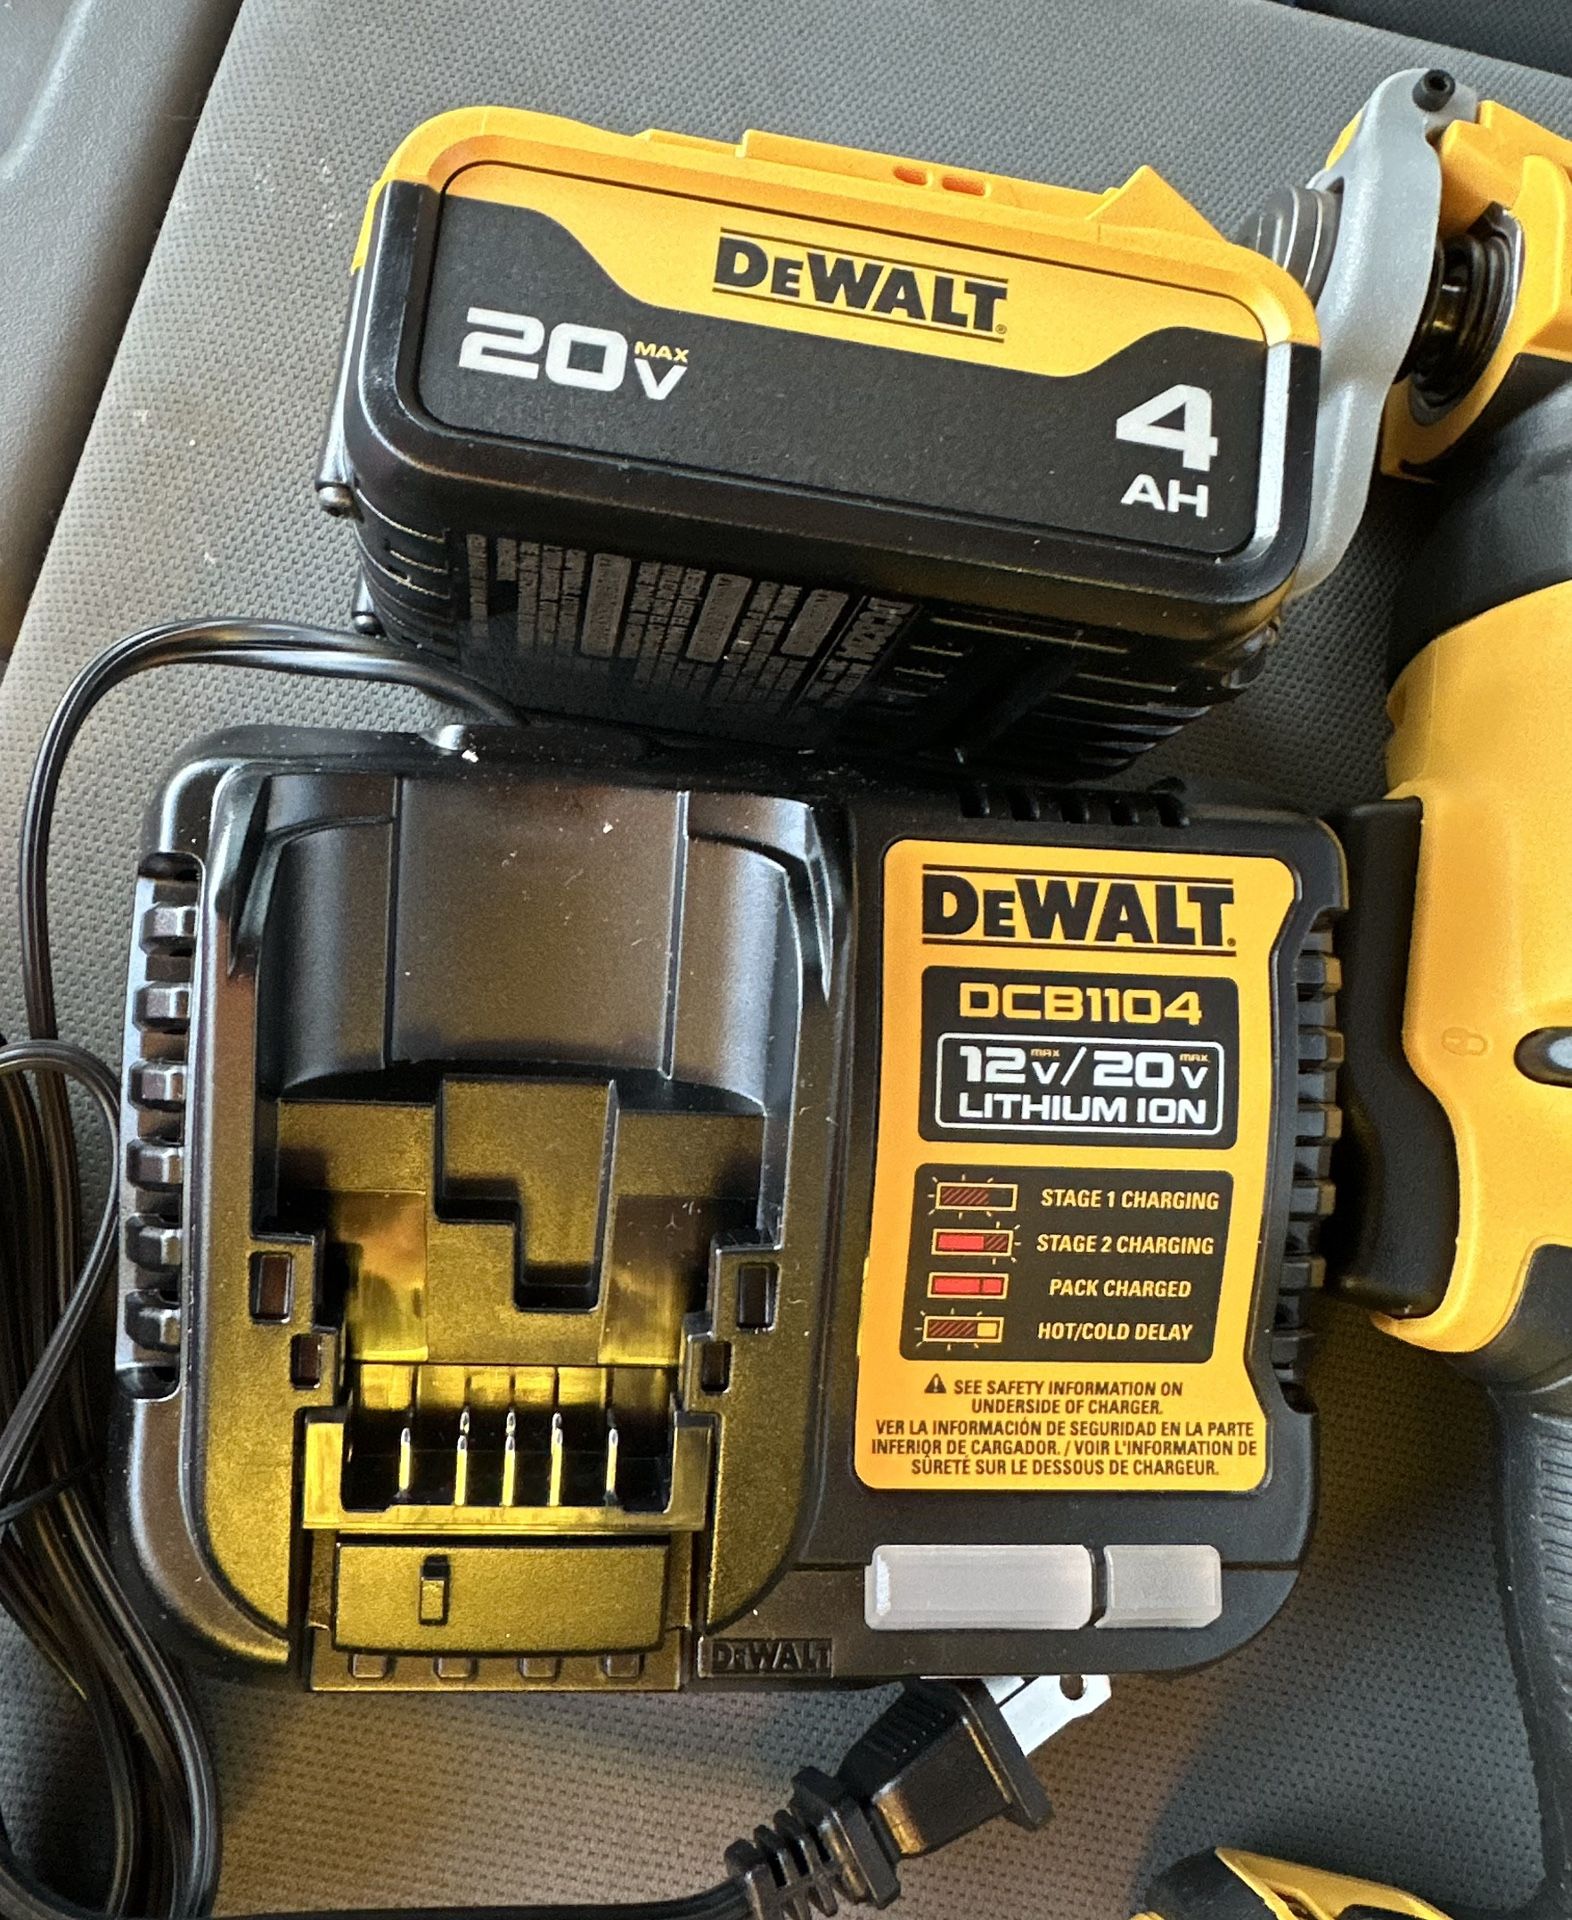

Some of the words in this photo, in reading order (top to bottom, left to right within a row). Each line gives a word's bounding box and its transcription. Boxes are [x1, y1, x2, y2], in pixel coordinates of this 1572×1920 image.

[712, 235, 1008, 334] DEWALT
[634, 341, 689, 364] MAX
[1116, 384, 1218, 472] 4
[1120, 473, 1209, 518] AH
[922, 873, 1235, 946] DEWALT
[959, 982, 1202, 1026] DCB1104
[959, 1092, 1127, 1123] LITHIUM
[1137, 1098, 1206, 1124] ION
[1041, 1188, 1102, 1208] STAGE
[1107, 1191, 1116, 1208] 1
[1121, 1190, 1220, 1210] CHARGING
[1036, 1234, 1097, 1253] STAGE
[1100, 1236, 1112, 1253] 2
[1116, 1236, 1214, 1255] CHARGING
[1049, 1279, 1099, 1297] PACK
[1103, 1279, 1192, 1298] CHARGED
[1038, 1322, 1130, 1341] HOT/COLD
[1134, 1323, 1193, 1341] DELAY
[954, 1379, 982, 1395] SEE
[987, 1380, 1044, 1395] SAFETY
[1049, 1381, 1156, 1396] INFORMATION
[1160, 1382, 1183, 1396] ON
[972, 1399, 1060, 1414] UNDERSIDE
[1065, 1400, 1085, 1414] OF
[1088, 1400, 1164, 1415] CHARGER.
[876, 1419, 905, 1435] VER
[909, 1420, 928, 1435] LA
[933, 1416, 1042, 1436] INFORMACIÓN
[1047, 1420, 1066, 1436] DE
[1070, 1421, 1156, 1436] SEGURIDAD
[1161, 1422, 1181, 1437] EN
[1185, 1422, 1203, 1437] LA
[1208, 1422, 1254, 1437] PARTE
[872, 1438, 942, 1455] INFERIOR
[947, 1439, 966, 1455] DE
[971, 1440, 1061, 1455] CARGADOR.
[1064, 1441, 1072, 1457] /
[1074, 1440, 1110, 1456] VOIR
[1114, 1440, 1233, 1456] L'INFORMATION
[1238, 1441, 1257, 1456] DE
[911, 1454, 971, 1475] SÛRETÉ
[975, 1459, 1006, 1475] SUR
[1011, 1459, 1028, 1475] LE
[1032, 1459, 1105, 1475] DESSOUS
[1109, 1459, 1129, 1475] DE
[1132, 1459, 1219, 1476] CHARGEUR.
[712, 1641, 832, 1672] DEWALT
